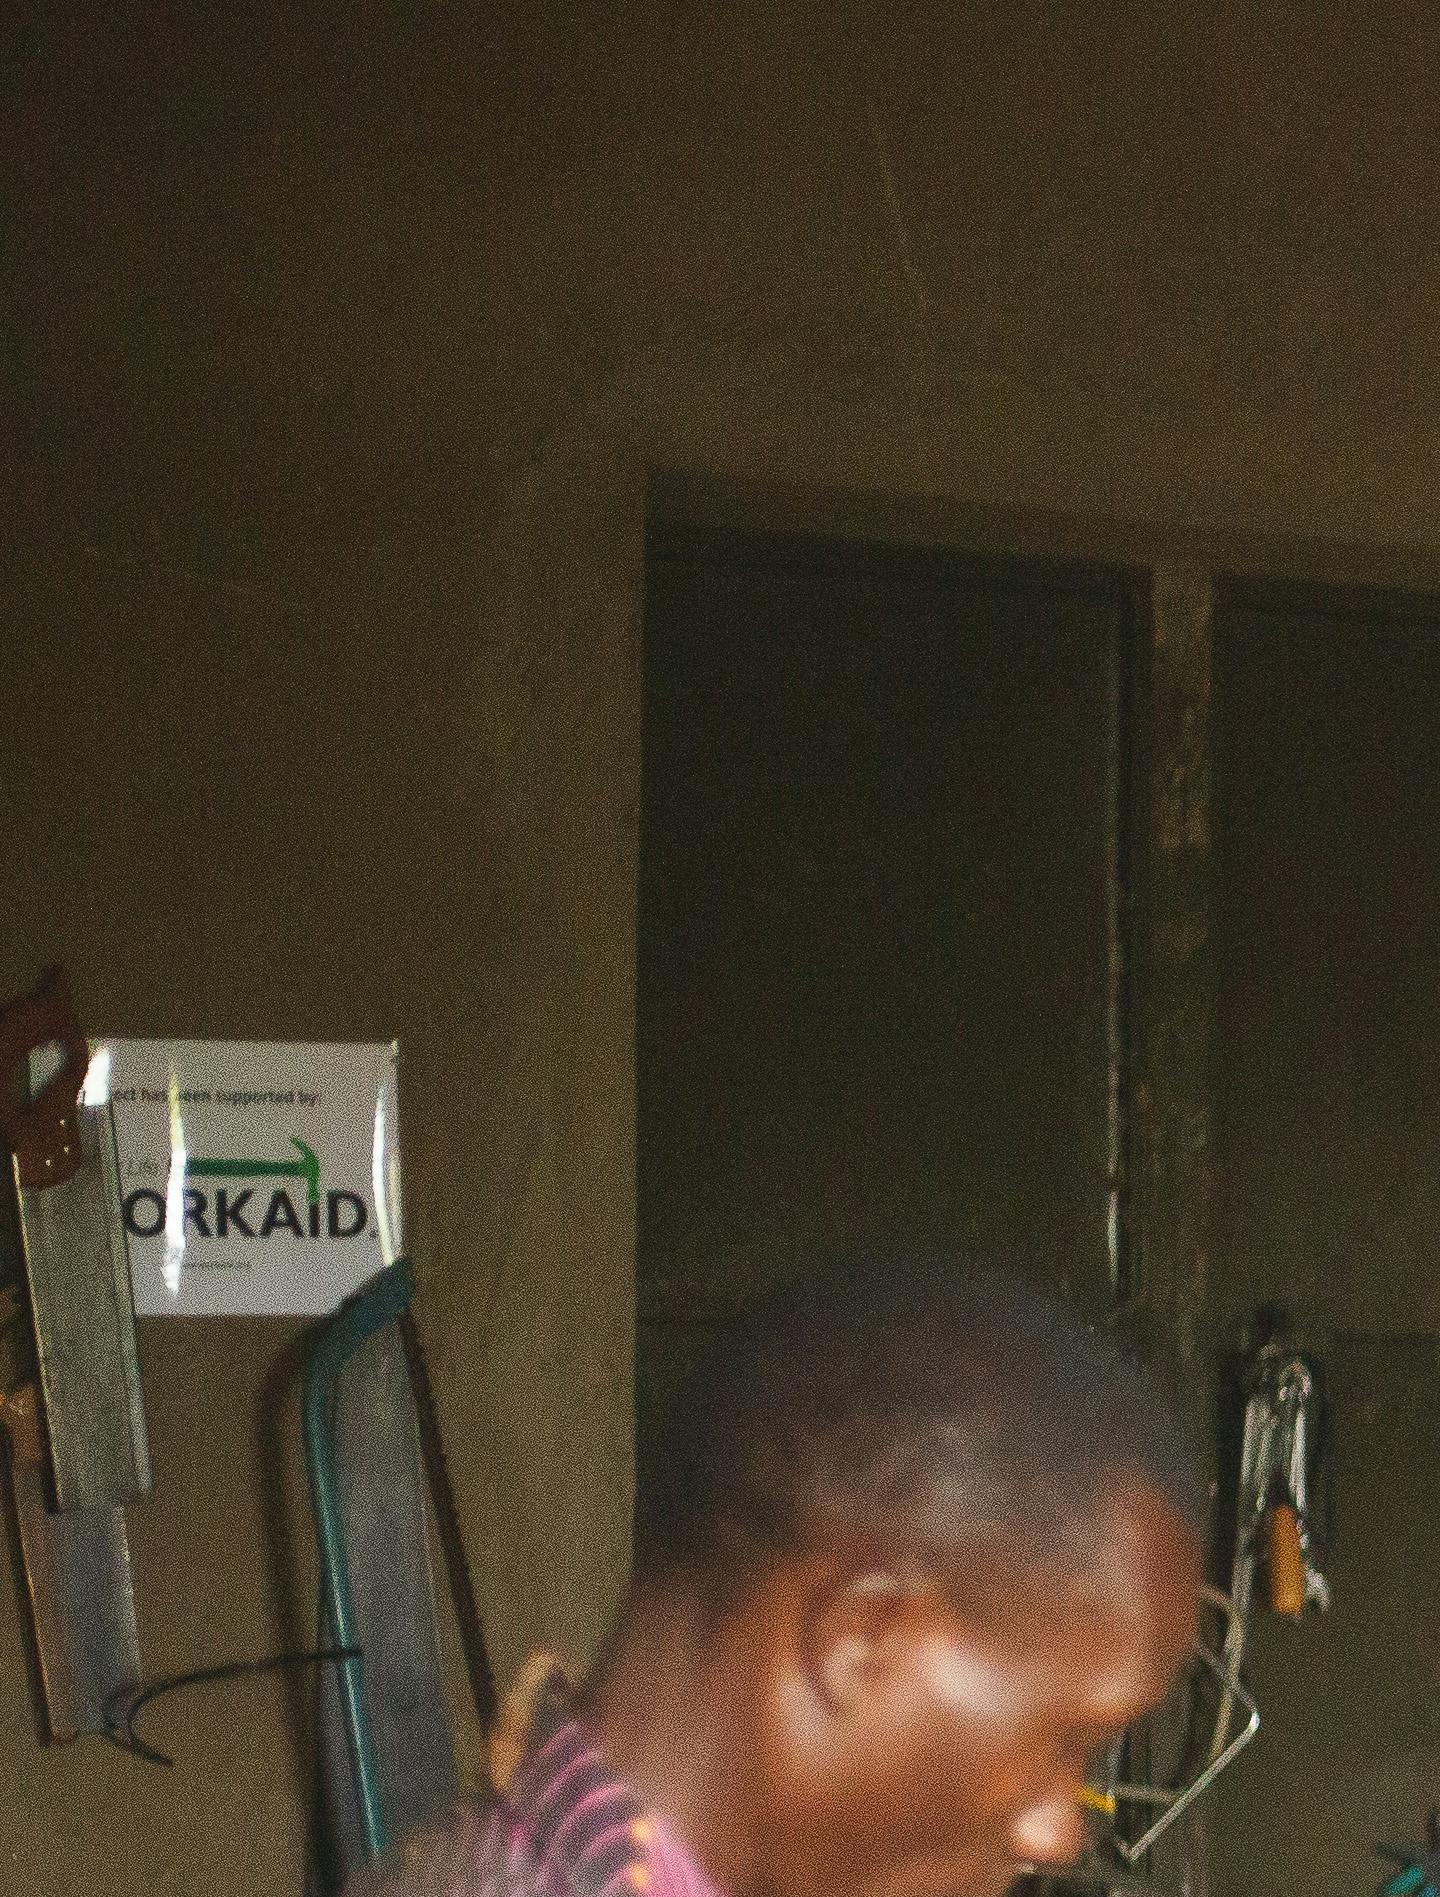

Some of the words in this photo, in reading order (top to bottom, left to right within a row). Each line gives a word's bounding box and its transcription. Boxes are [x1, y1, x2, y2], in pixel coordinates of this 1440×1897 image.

[178, 1086, 210, 1101] een
[213, 1087, 295, 1107] supported
[121, 1187, 377, 1240] ORKAID.
